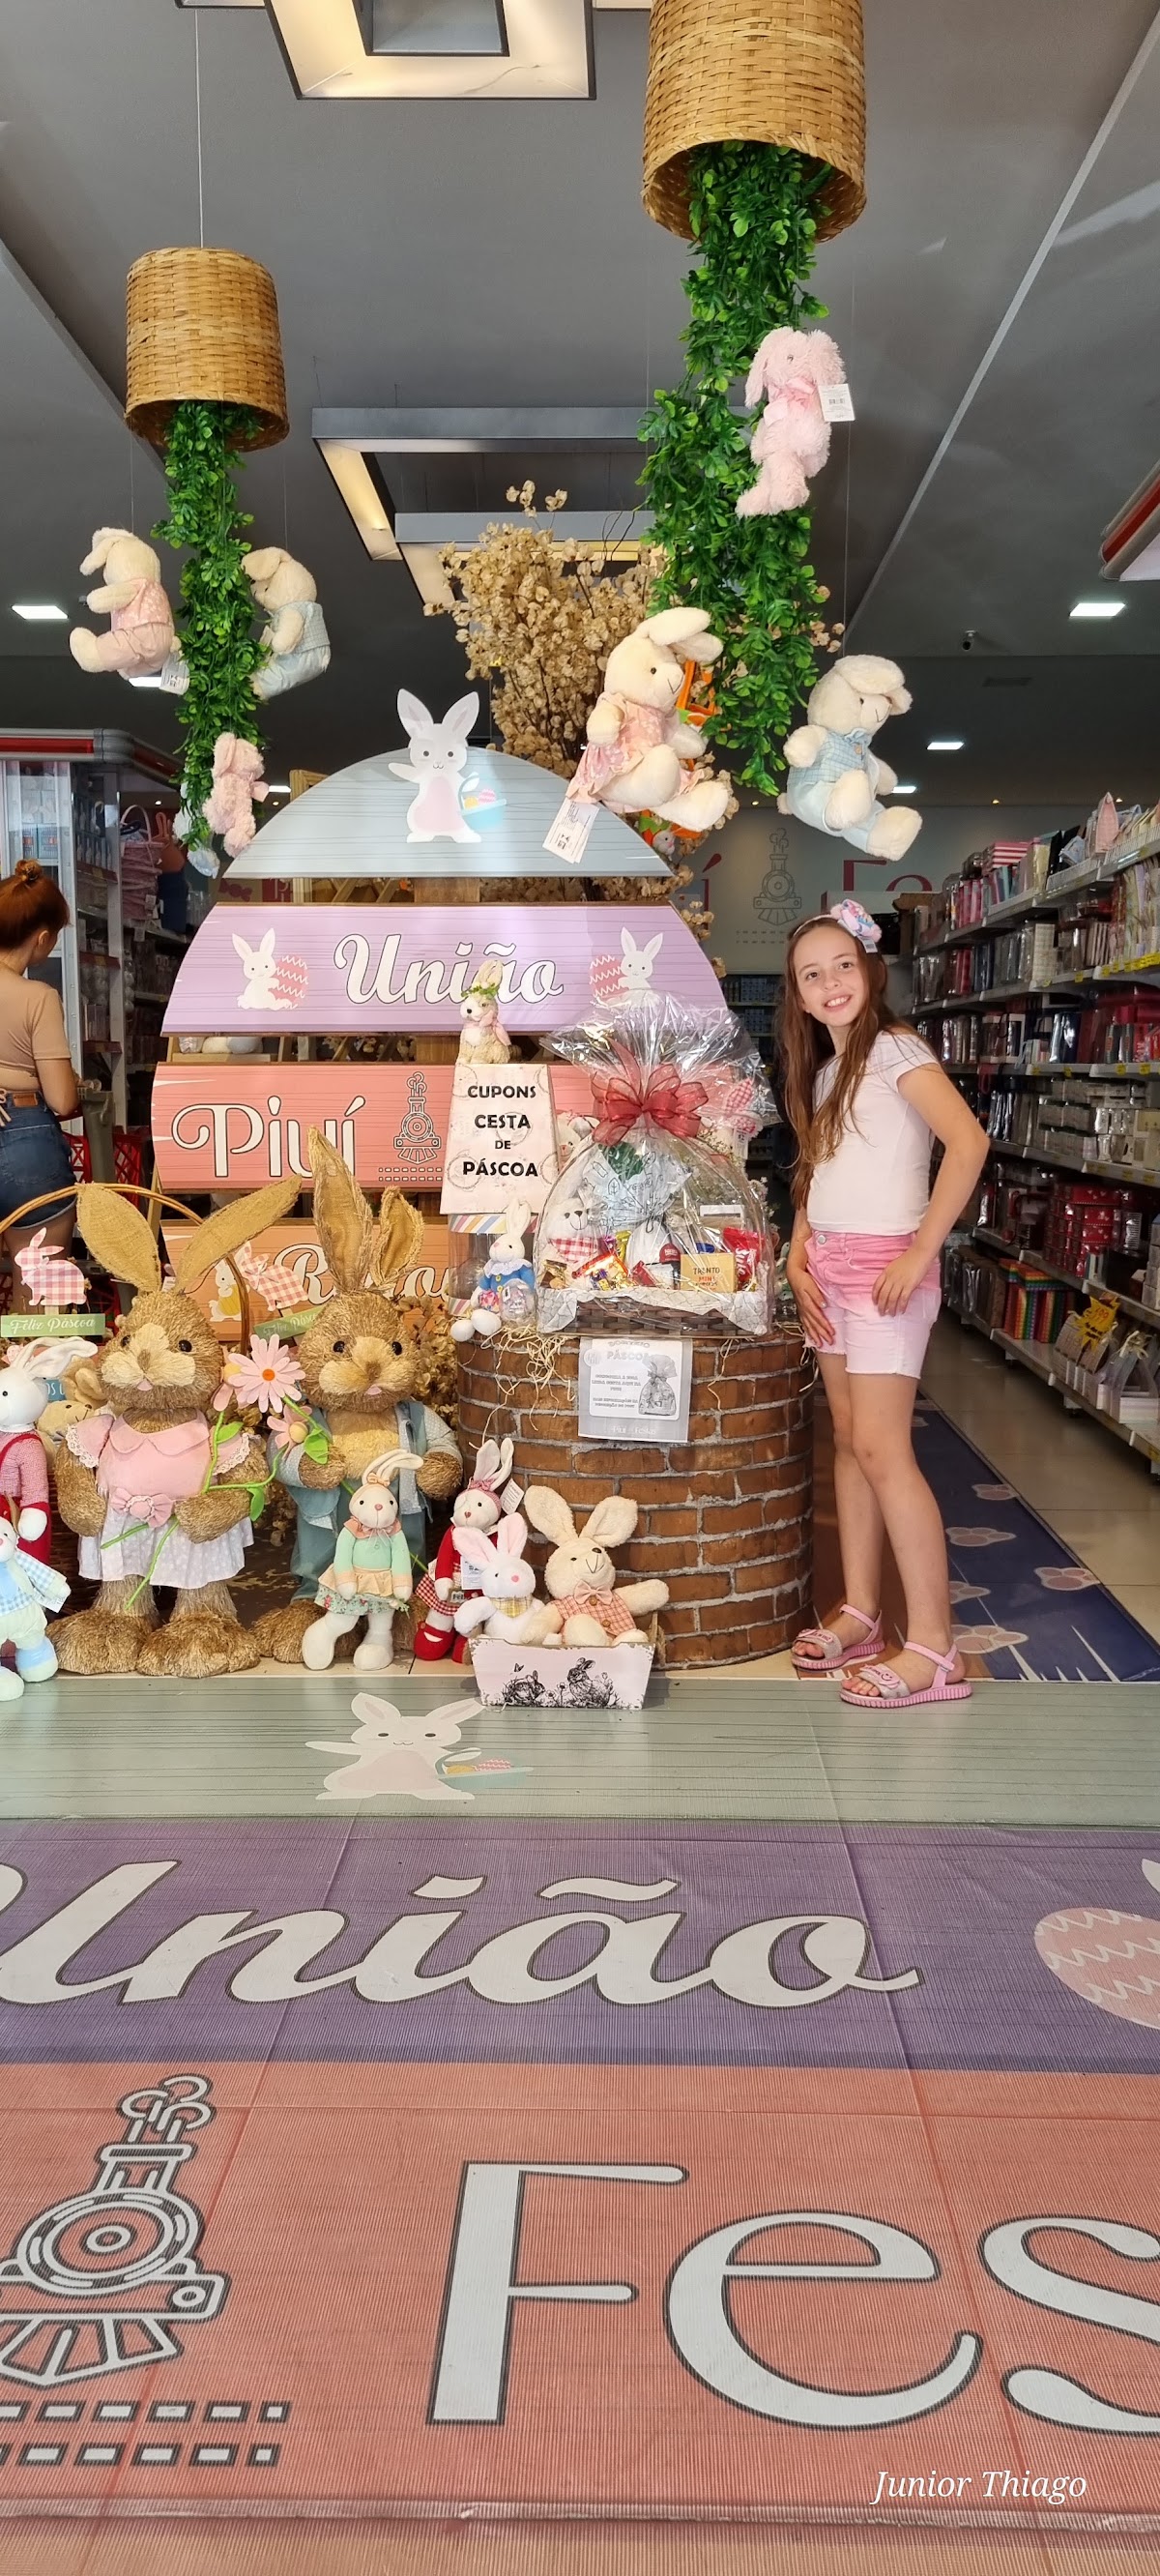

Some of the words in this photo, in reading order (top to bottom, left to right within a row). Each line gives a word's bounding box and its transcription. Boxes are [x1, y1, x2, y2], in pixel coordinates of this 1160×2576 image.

[334, 932, 565, 1004] União
[467, 1085, 536, 1098] CUPONS
[474, 1114, 531, 1130] CESTA
[171, 1095, 366, 1179] Piuí
[494, 1140, 511, 1150] DE
[462, 1157, 538, 1177] PÁSCOA
[10, 1319, 44, 1334] Feliz
[47, 1317, 96, 1332] Páscoa
[0, 1859, 920, 2009] União
